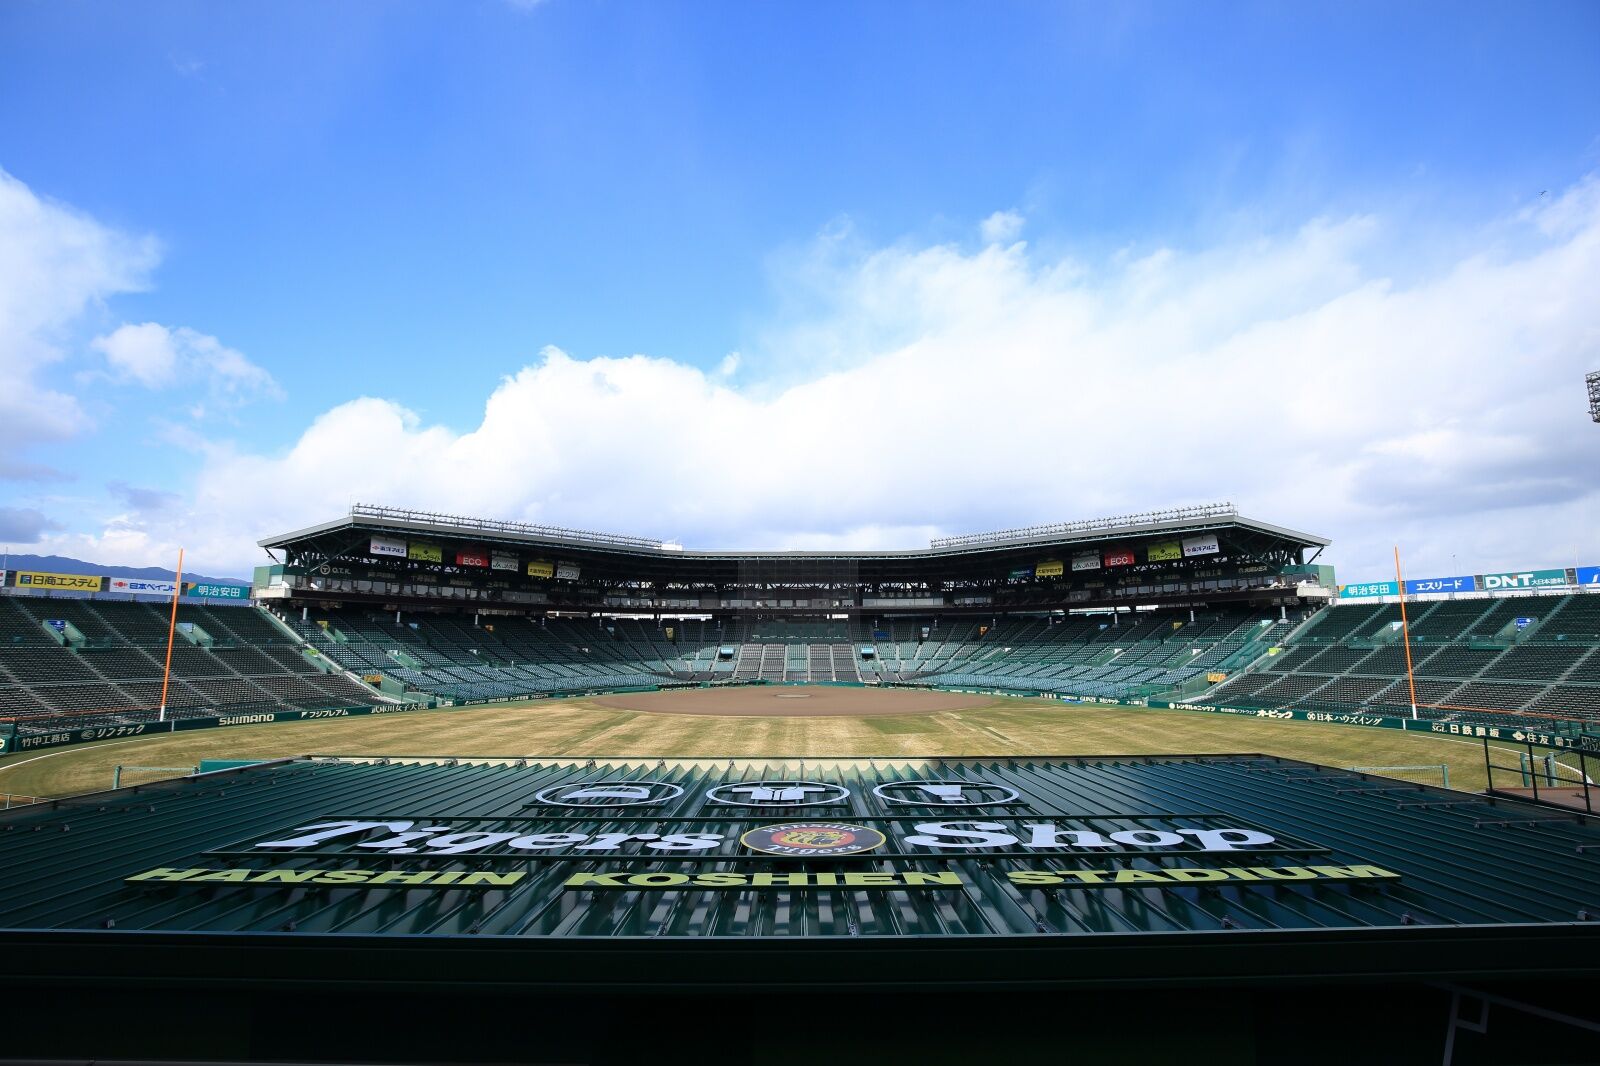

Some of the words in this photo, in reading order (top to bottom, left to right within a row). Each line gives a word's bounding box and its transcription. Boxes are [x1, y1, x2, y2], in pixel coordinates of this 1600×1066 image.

[462, 557, 482, 565] ECC
[1110, 557, 1128, 565] ECC
[33, 575, 98, 588] 日商エステム
[129, 582, 176, 591] 日本ペイント
[1416, 580, 1462, 591] エスリード
[1485, 573, 1533, 588] DNT
[198, 585, 240, 597] 明治安田
[1347, 584, 1390, 596] 明治安田
[218, 713, 275, 726] SHIMANO
[309, 709, 349, 719] フジプレアム
[1257, 710, 1293, 719] オービック
[1316, 713, 1383, 726] 日本ハウズイング
[97, 724, 146, 738] リンテック
[22, 732, 71, 748] 竹中工務店
[253, 820, 726, 854] Tigers
[903, 820, 1276, 852] Shop
[126, 868, 530, 885] HANSHIN
[565, 871, 964, 887] KOSHIEN
[1006, 864, 1400, 884] STADIUM
